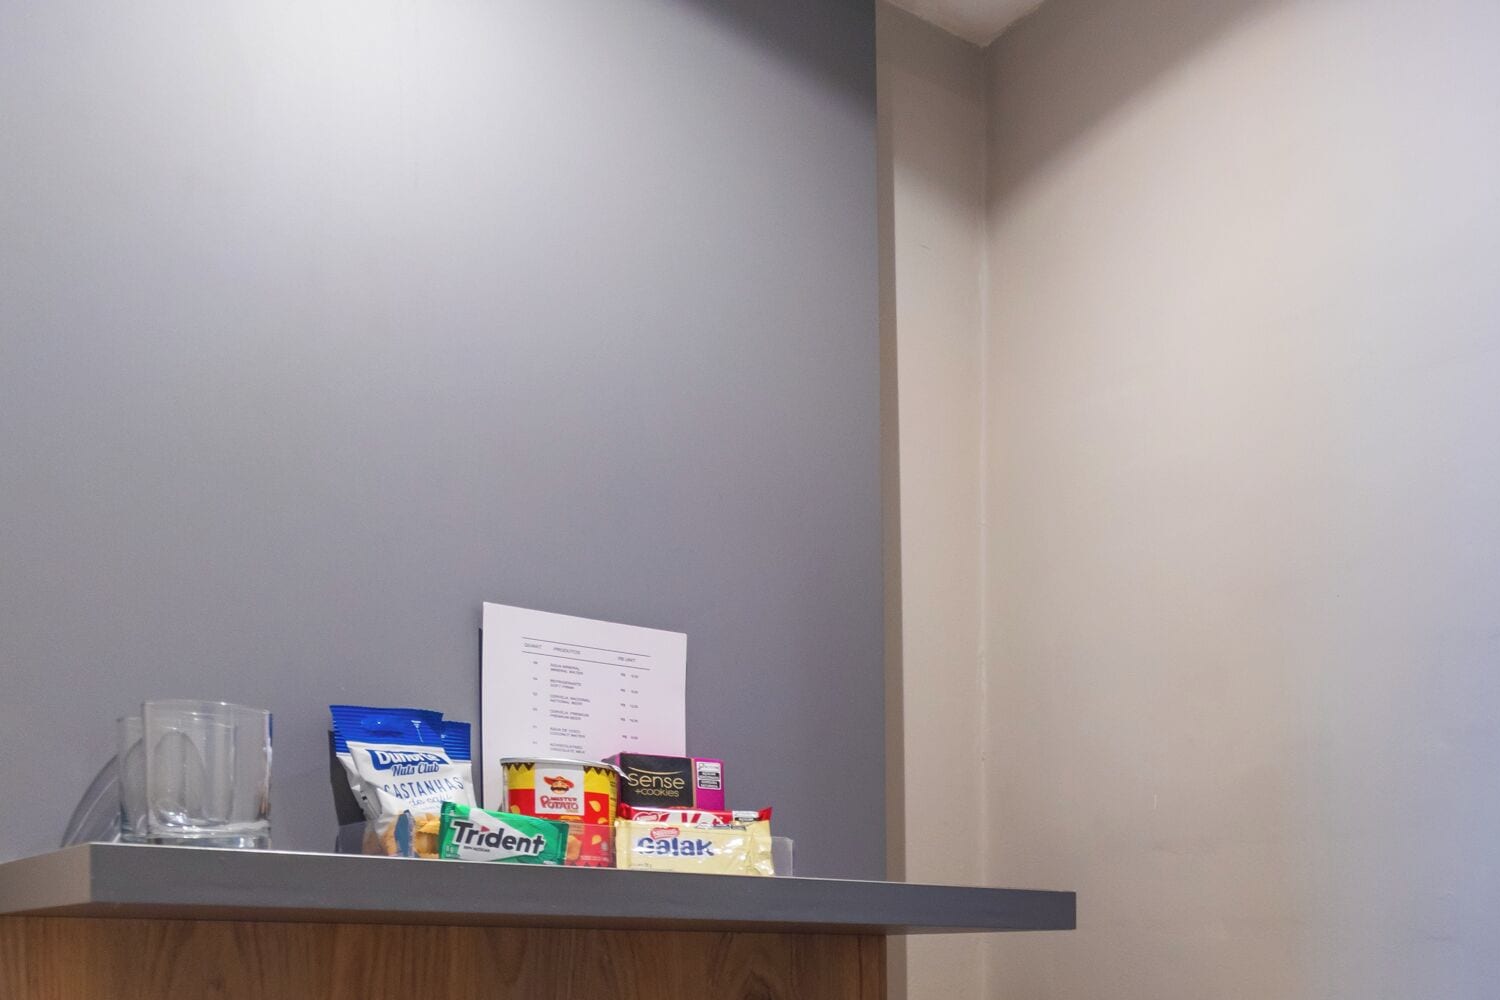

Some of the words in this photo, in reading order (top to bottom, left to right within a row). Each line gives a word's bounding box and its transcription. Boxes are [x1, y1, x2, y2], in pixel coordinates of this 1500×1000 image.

[392, 764, 415, 776] Nuts
[418, 762, 440, 774] Club
[384, 776, 464, 799] CASTANHAS
[627, 773, 685, 790] Sense
[454, 821, 545, 855] Trident
[637, 837, 715, 857] Galak
